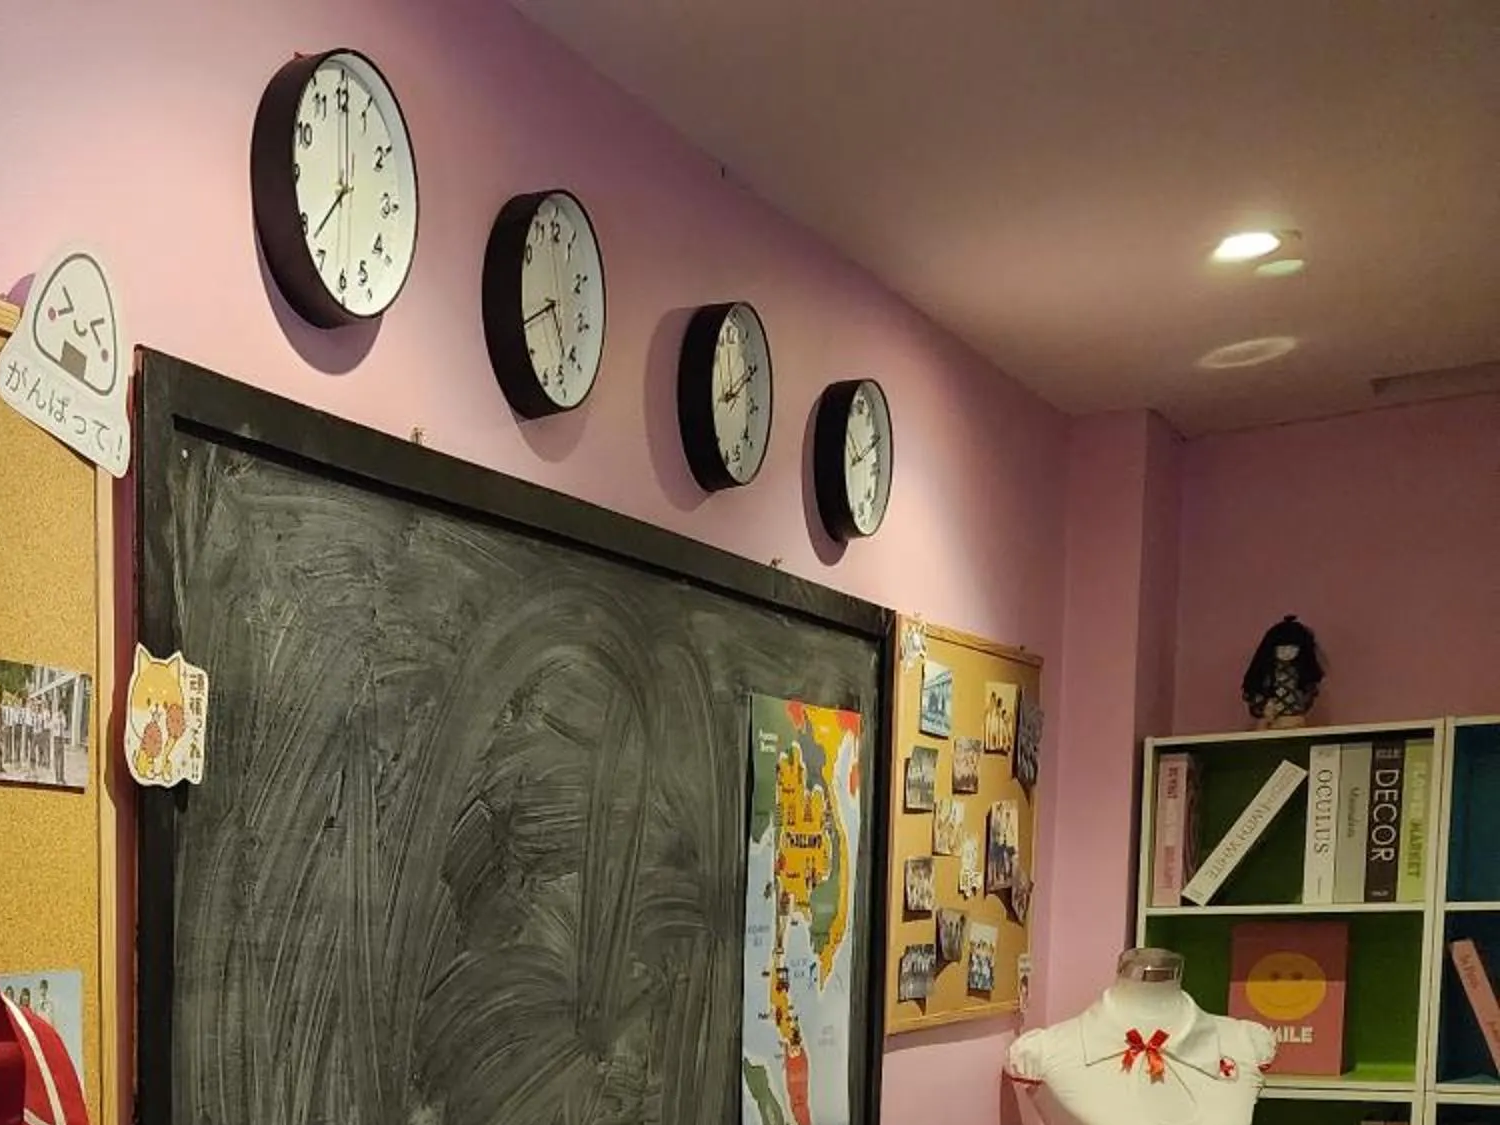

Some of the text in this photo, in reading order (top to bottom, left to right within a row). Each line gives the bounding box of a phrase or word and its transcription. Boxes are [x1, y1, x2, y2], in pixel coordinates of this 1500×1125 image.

[314, 92, 327, 121] 11
[336, 87, 349, 112] 12
[298, 120, 313, 148] 10
[374, 145, 384, 171] 2
[381, 192, 391, 219] 3
[372, 233, 384, 256] 4
[316, 248, 326, 272] 7
[358, 260, 369, 287] 5
[338, 268, 347, 293] 6
[5, 361, 124, 461] がんばって!
[1314, 769, 1333, 854] OCULUS
[1370, 769, 1399, 861] DECOR
[1269, 1026, 1314, 1043] MILE
